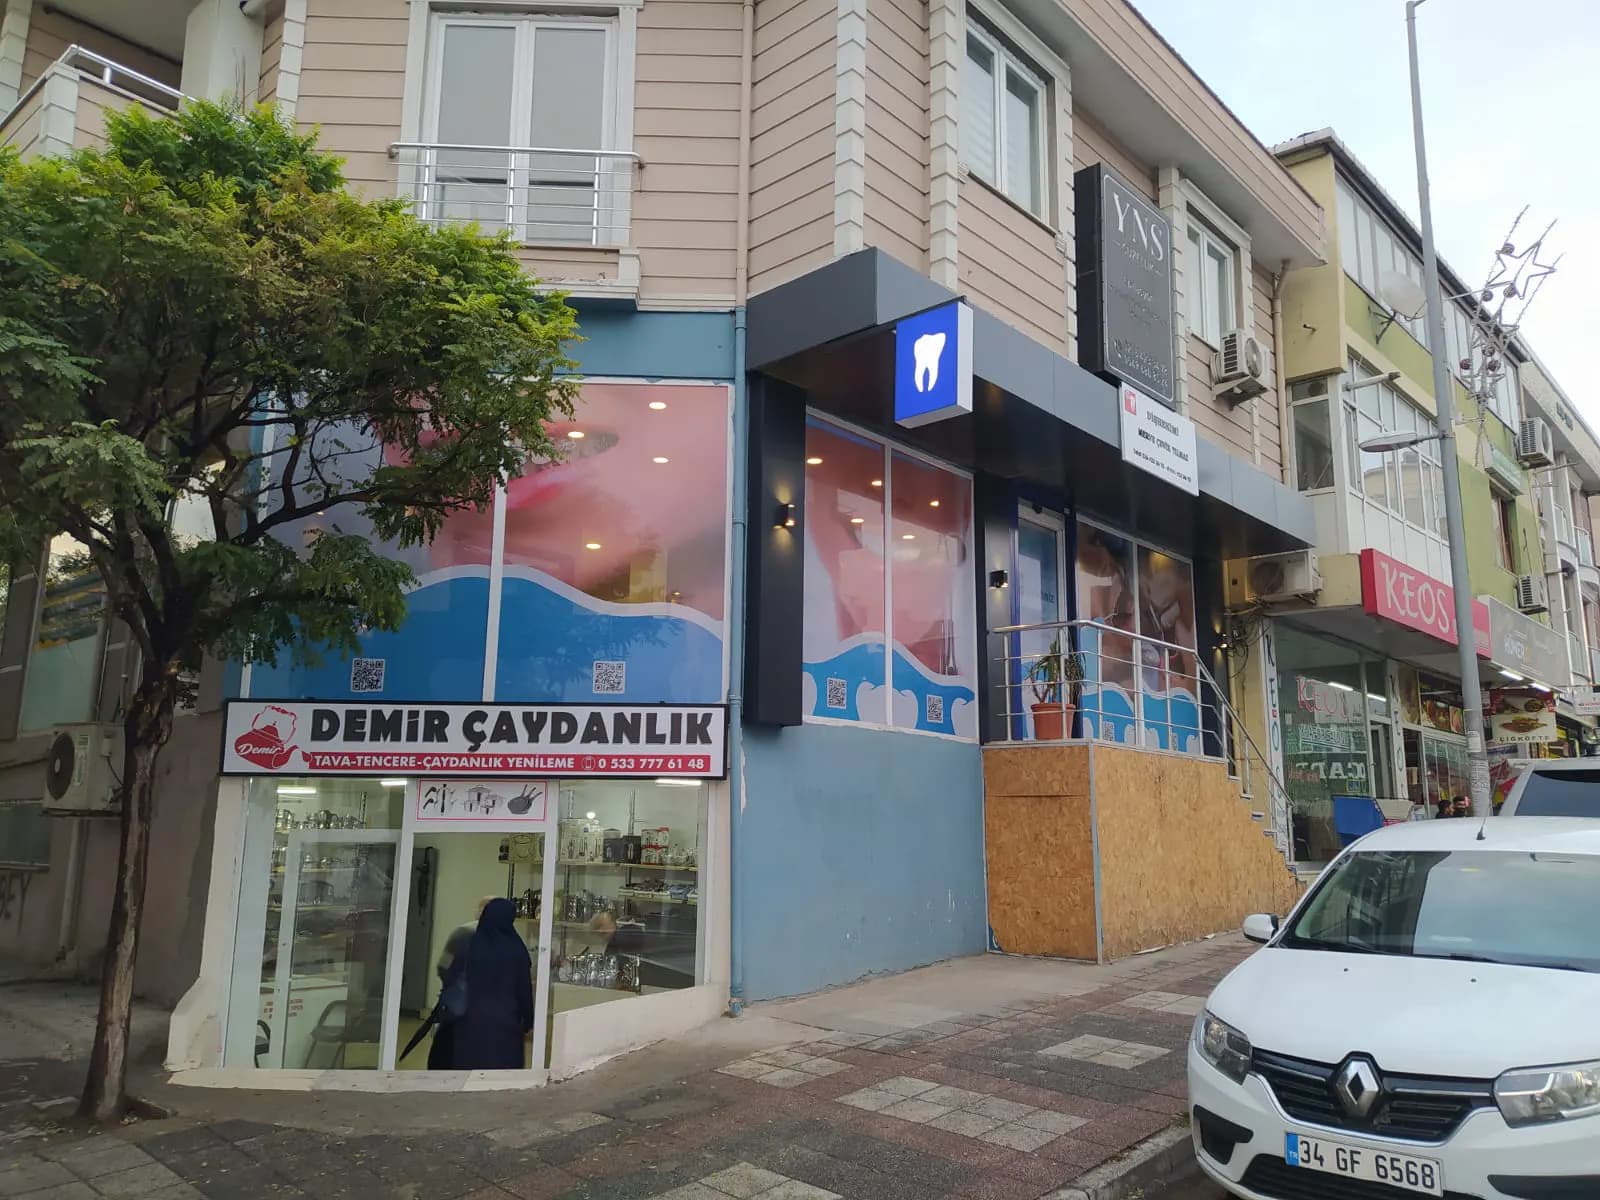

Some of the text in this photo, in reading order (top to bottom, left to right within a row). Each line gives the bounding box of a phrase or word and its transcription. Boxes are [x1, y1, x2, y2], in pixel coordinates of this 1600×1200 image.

[1113, 192, 1163, 261] YNS
[1379, 560, 1450, 634] KEOS
[238, 743, 282, 755] Demir
[462, 709, 713, 752] ÇAYDANLIK
[315, 755, 704, 770] TAVA-TENCERE-ÇAYDANLIK YENİLEME 0 533 777 61 48
[1300, 1140, 1436, 1190] 34 GF 6568
